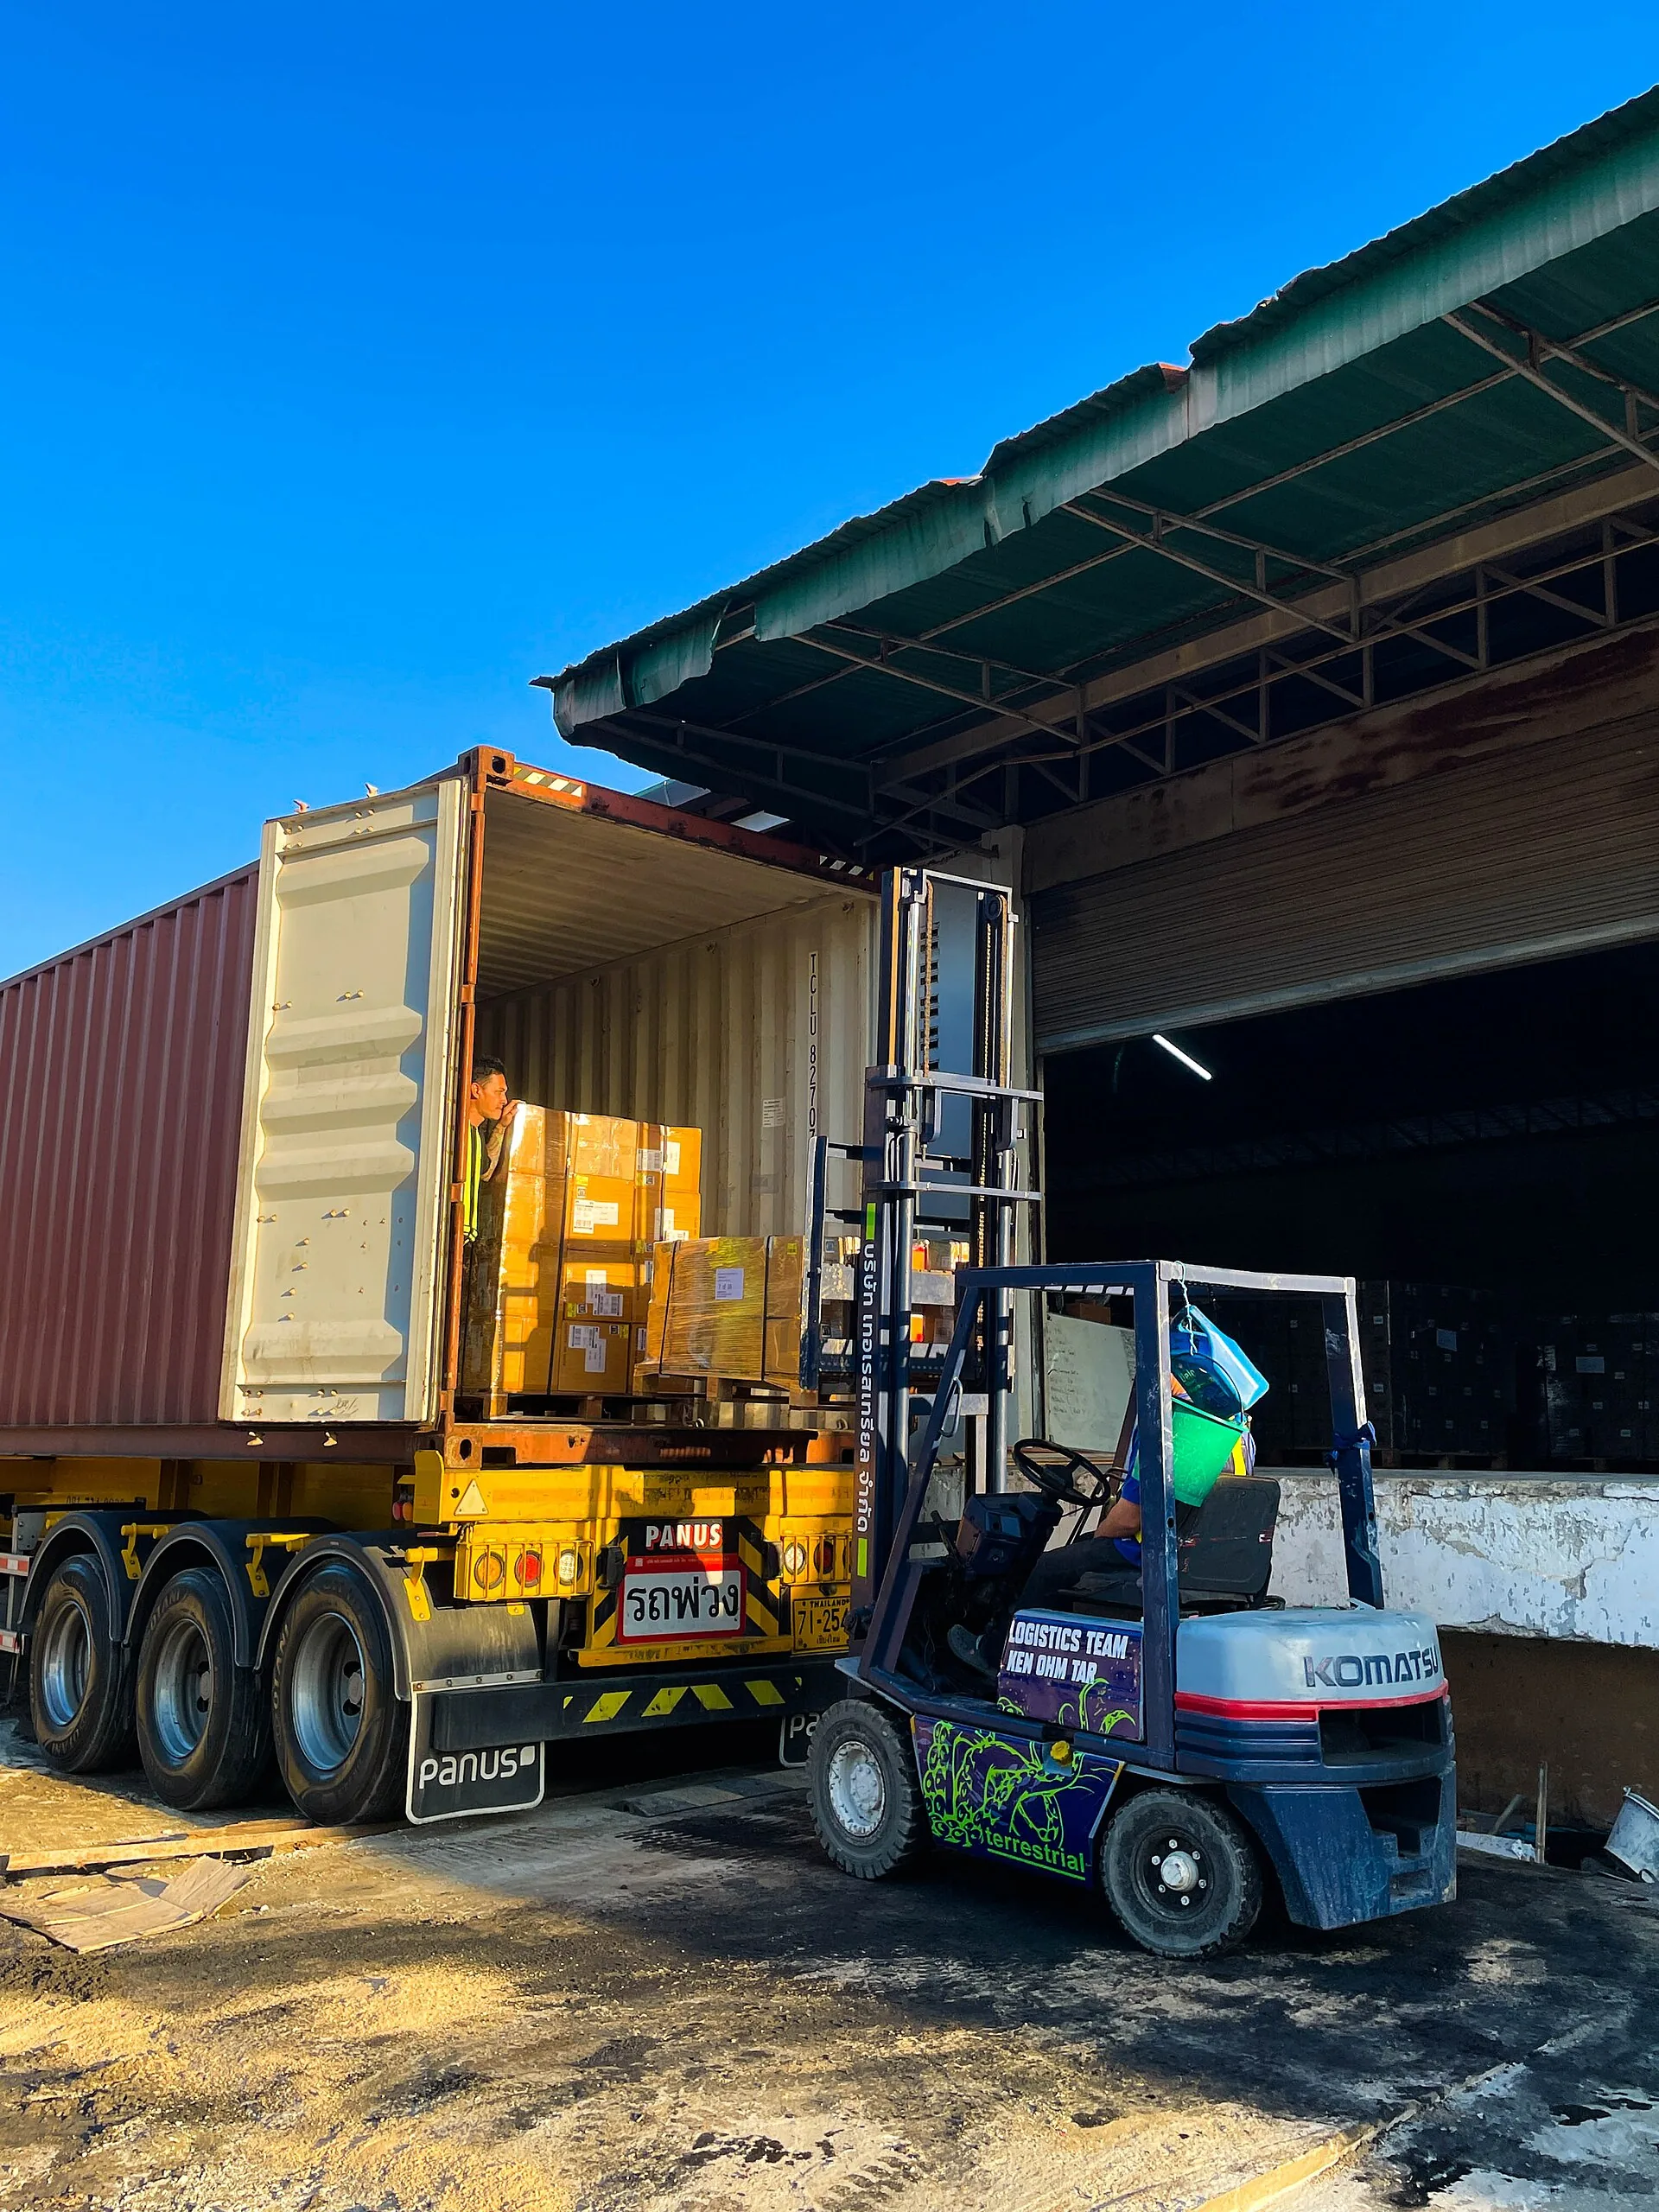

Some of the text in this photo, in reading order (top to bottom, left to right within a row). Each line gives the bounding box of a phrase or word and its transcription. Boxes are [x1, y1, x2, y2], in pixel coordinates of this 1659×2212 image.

[862, 1243, 877, 1306] บริษัท
[857, 1470, 874, 1533] จำกัด
[645, 1522, 723, 1550] PANUS
[626, 1576, 739, 1622] รถพ่วง
[810, 1599, 846, 1608] THAILAND
[1007, 1619, 1129, 1660] LOGISTICS TEAM
[1006, 1649, 1098, 1685] KEN OHM TAR
[1303, 1644, 1440, 1688] KOMATSU
[985, 1827, 1085, 1873] terrestrial
